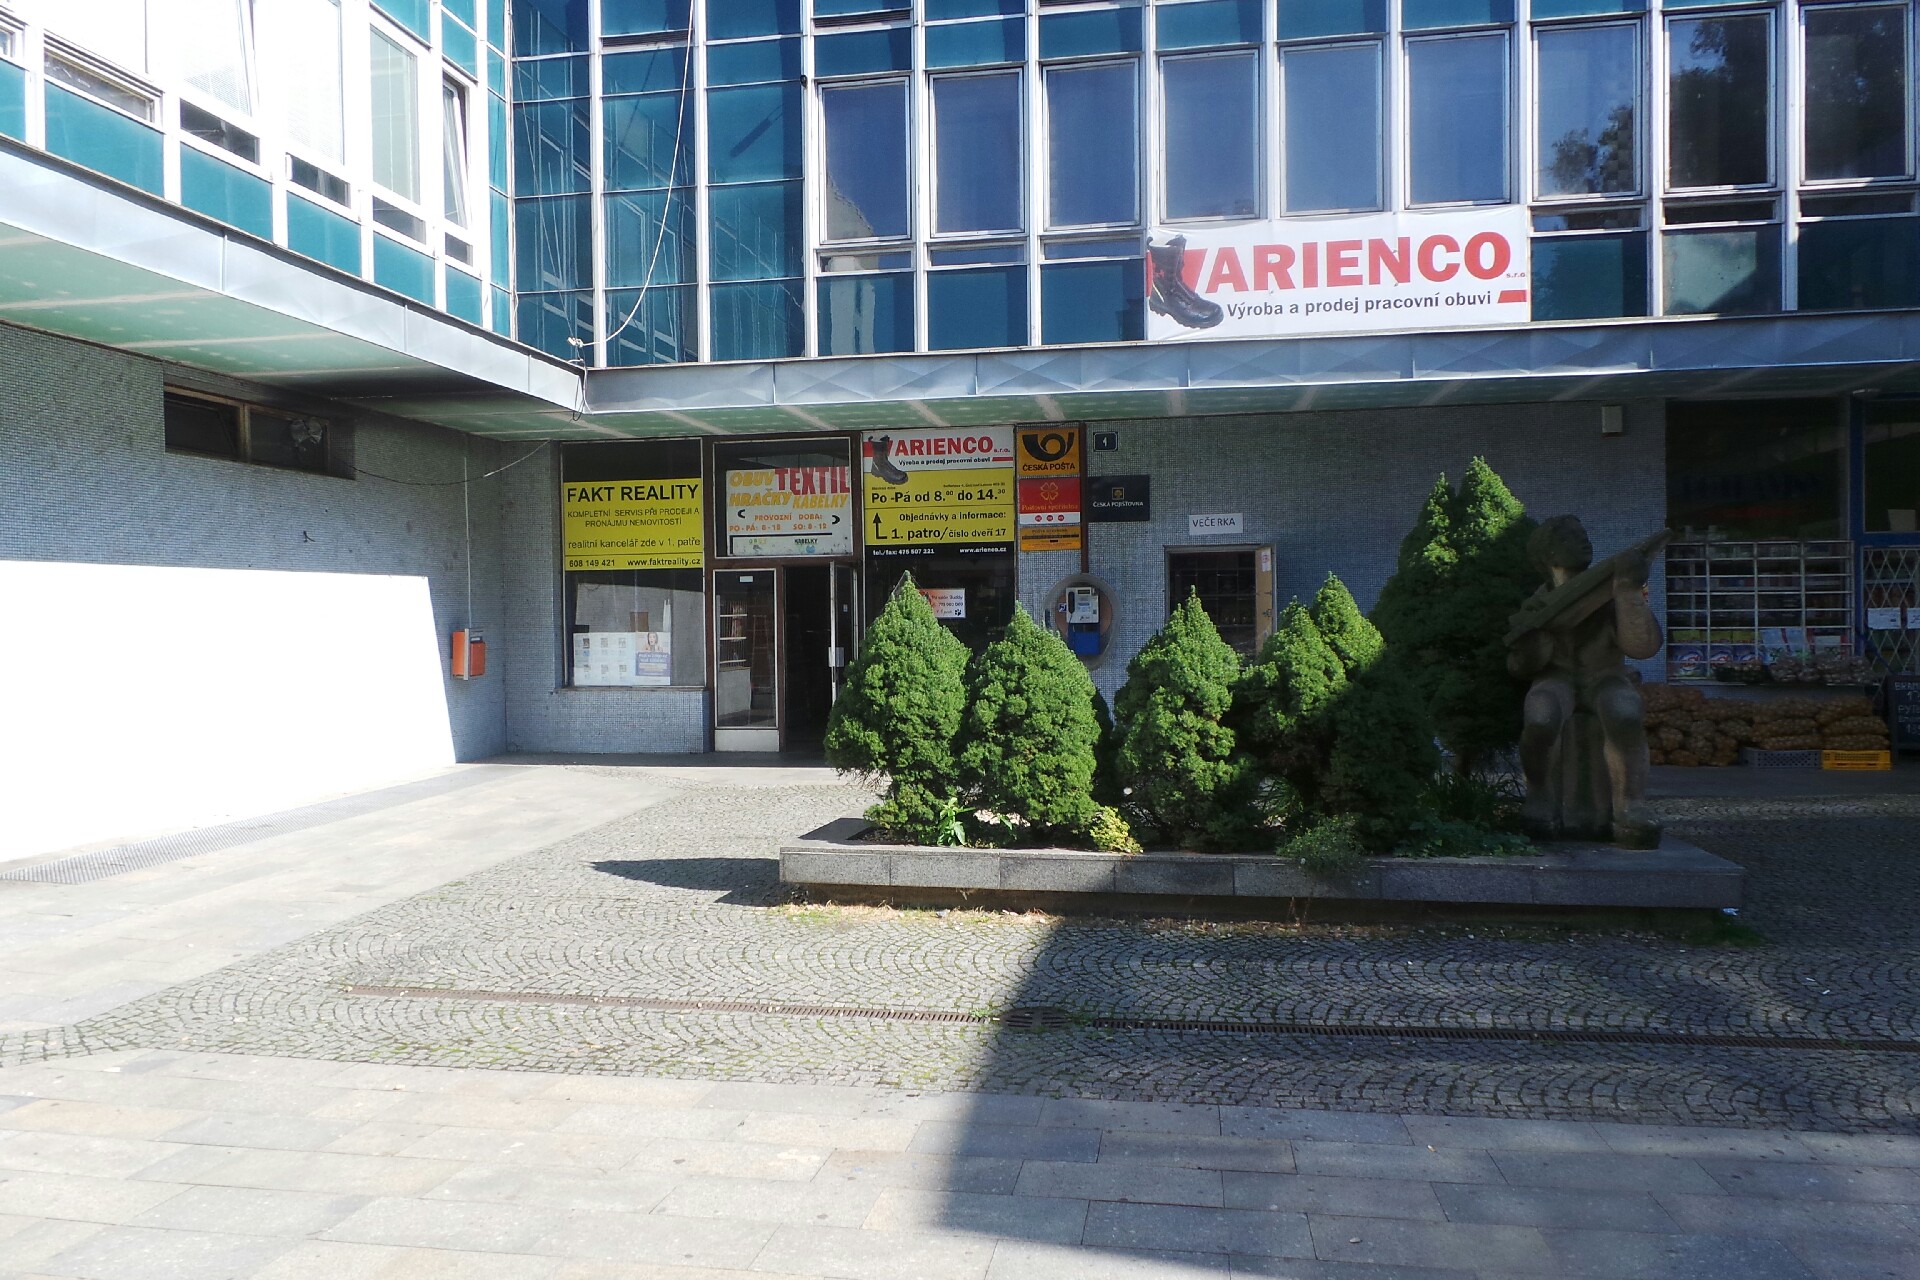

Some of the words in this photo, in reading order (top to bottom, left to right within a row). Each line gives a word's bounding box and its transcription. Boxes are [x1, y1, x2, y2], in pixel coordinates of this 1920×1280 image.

[1205, 231, 1511, 294] ARIENCO
[1227, 302, 1284, 319] Výroba
[1289, 304, 1299, 314] a
[1305, 299, 1359, 317] prodej
[1364, 293, 1440, 313] pracovní
[1445, 291, 1492, 306] obuvi
[895, 436, 994, 456] ARIENCO
[1102, 436, 1108, 447] 1
[926, 458, 946, 466] prodej
[947, 457, 973, 465] pracovní
[1022, 462, 1048, 471] ČESKÁ
[1049, 462, 1076, 470] POŠTA
[729, 471, 775, 487] OBUV
[774, 466, 850, 496] TEXTIL
[567, 487, 615, 502] FAKT
[621, 484, 699, 501] REALITY
[729, 488, 793, 507] HRAČKY
[792, 493, 849, 509] KABELKY
[871, 492, 887, 503] Po
[914, 491, 930, 502] od
[957, 490, 973, 501] do
[567, 509, 611, 518] KOMPLETNÍ
[614, 509, 643, 517] SERVIS
[644, 507, 658, 516] PŘI
[659, 507, 692, 516] PRODEJI
[693, 507, 700, 515] A
[754, 512, 792, 521] PROVOZNÍ
[899, 512, 949, 522] Objednávky
[959, 512, 1007, 520] informace:
[585, 519, 628, 527] PRONÁJMU
[629, 518, 682, 526] NEMOVITOSTÍ
[729, 524, 740, 532] PO
[891, 528, 904, 539] 1.
[971, 528, 993, 536] dveří
[995, 528, 1007, 536] 17
[568, 540, 598, 549] realitní
[600, 539, 639, 548] kancelář
[640, 538, 656, 547] zde
[677, 536, 701, 547] patře
[569, 559, 583, 567] 608
[586, 559, 600, 567] 149
[601, 559, 615, 567] 421
[627, 558, 701, 567] www.faktreality.cz
